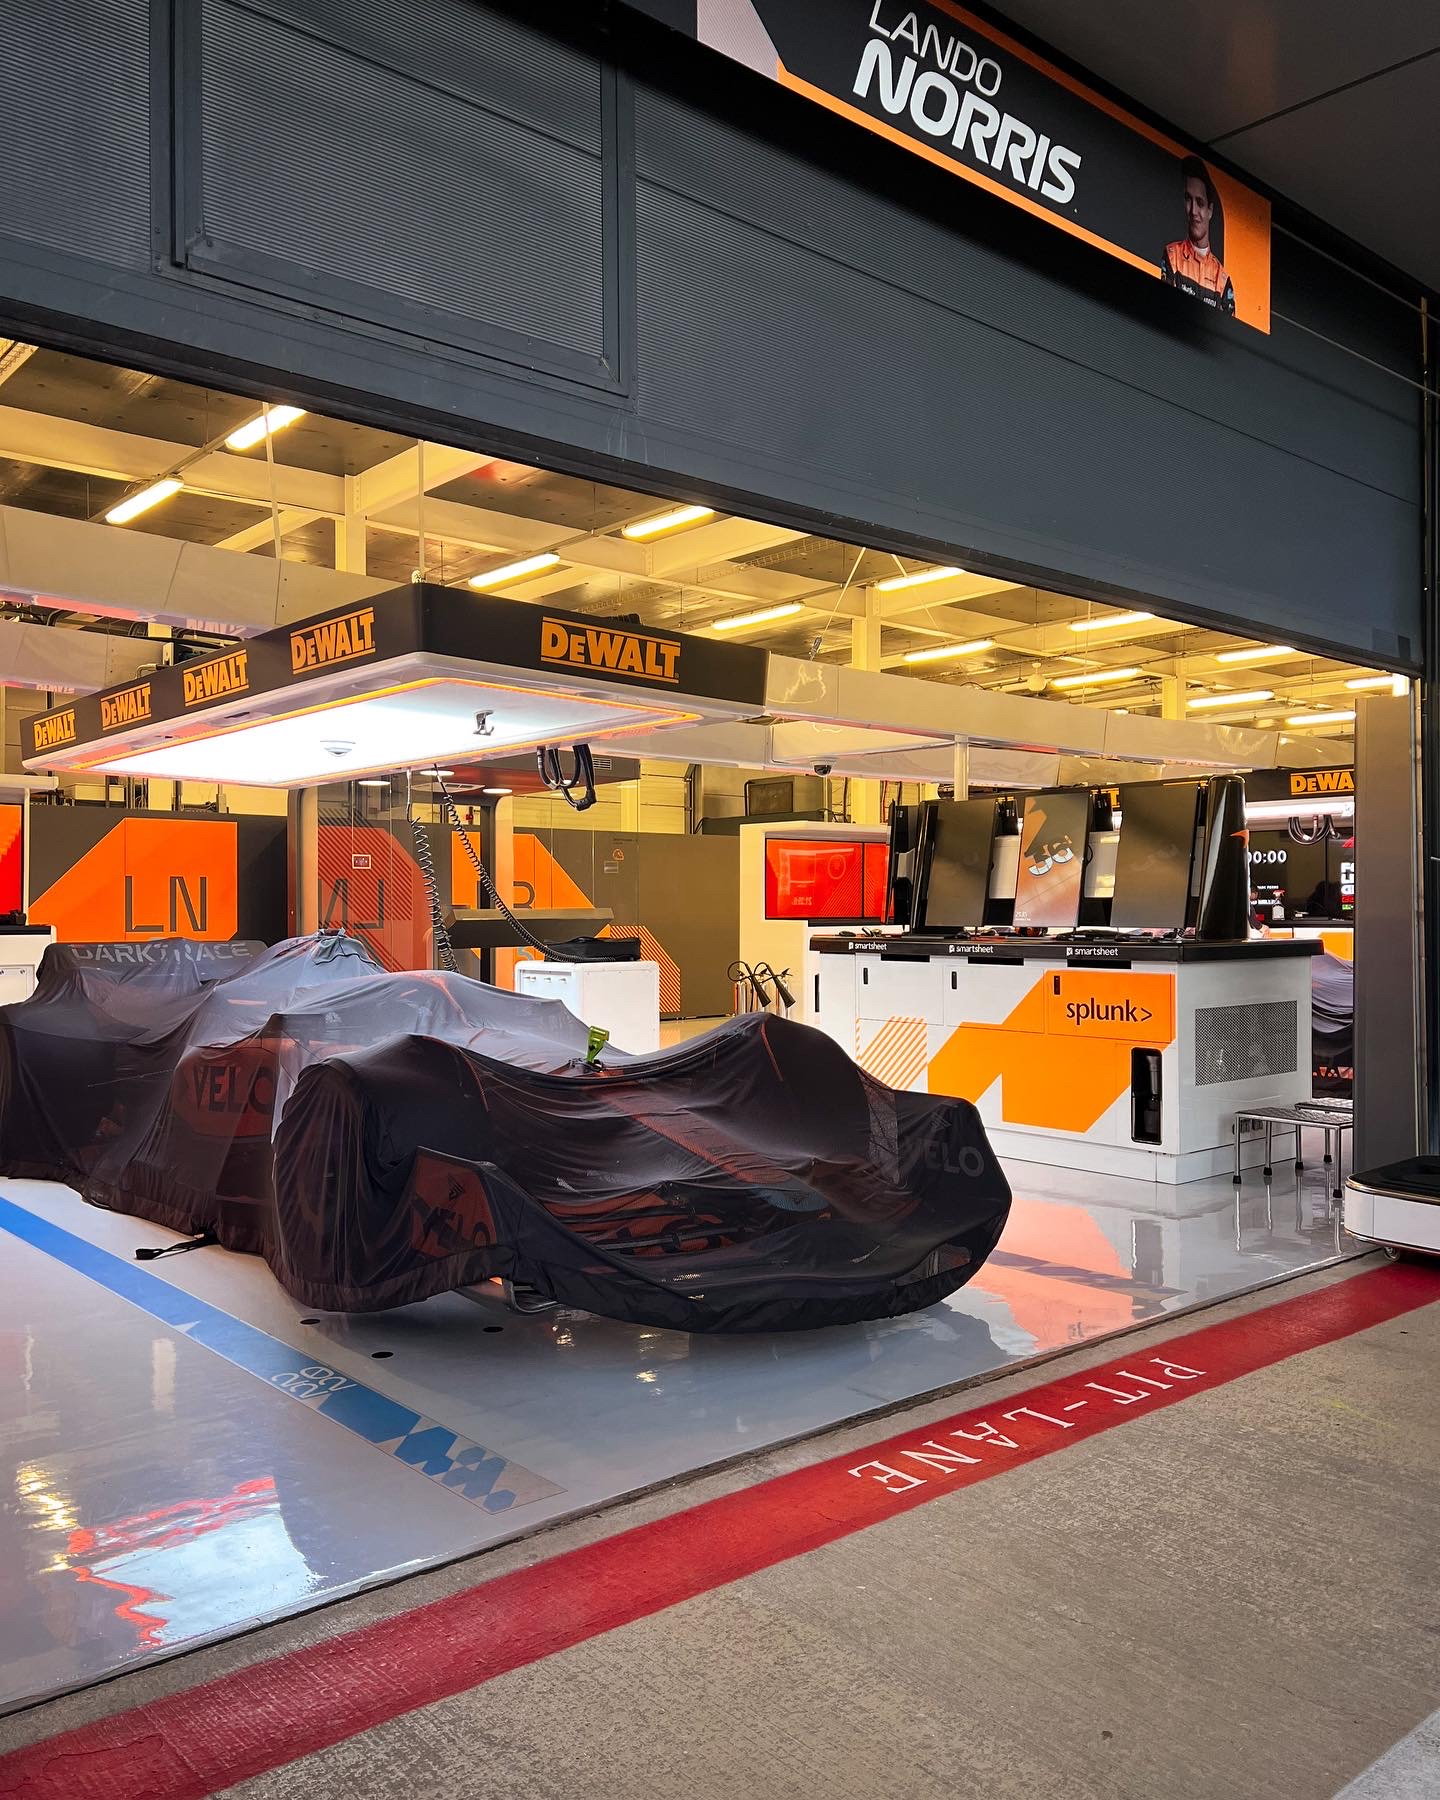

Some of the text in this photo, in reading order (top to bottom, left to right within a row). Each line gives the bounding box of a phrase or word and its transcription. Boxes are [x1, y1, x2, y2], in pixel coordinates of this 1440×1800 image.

[869, 0, 1002, 96] LANDO
[852, 38, 1082, 204] NORRIS
[1291, 772, 1354, 792] DEWA
[125, 875, 207, 932] LN
[855, 942, 887, 950] smartsheet
[956, 945, 993, 954] smartsheet
[1074, 947, 1118, 956] smartsheet
